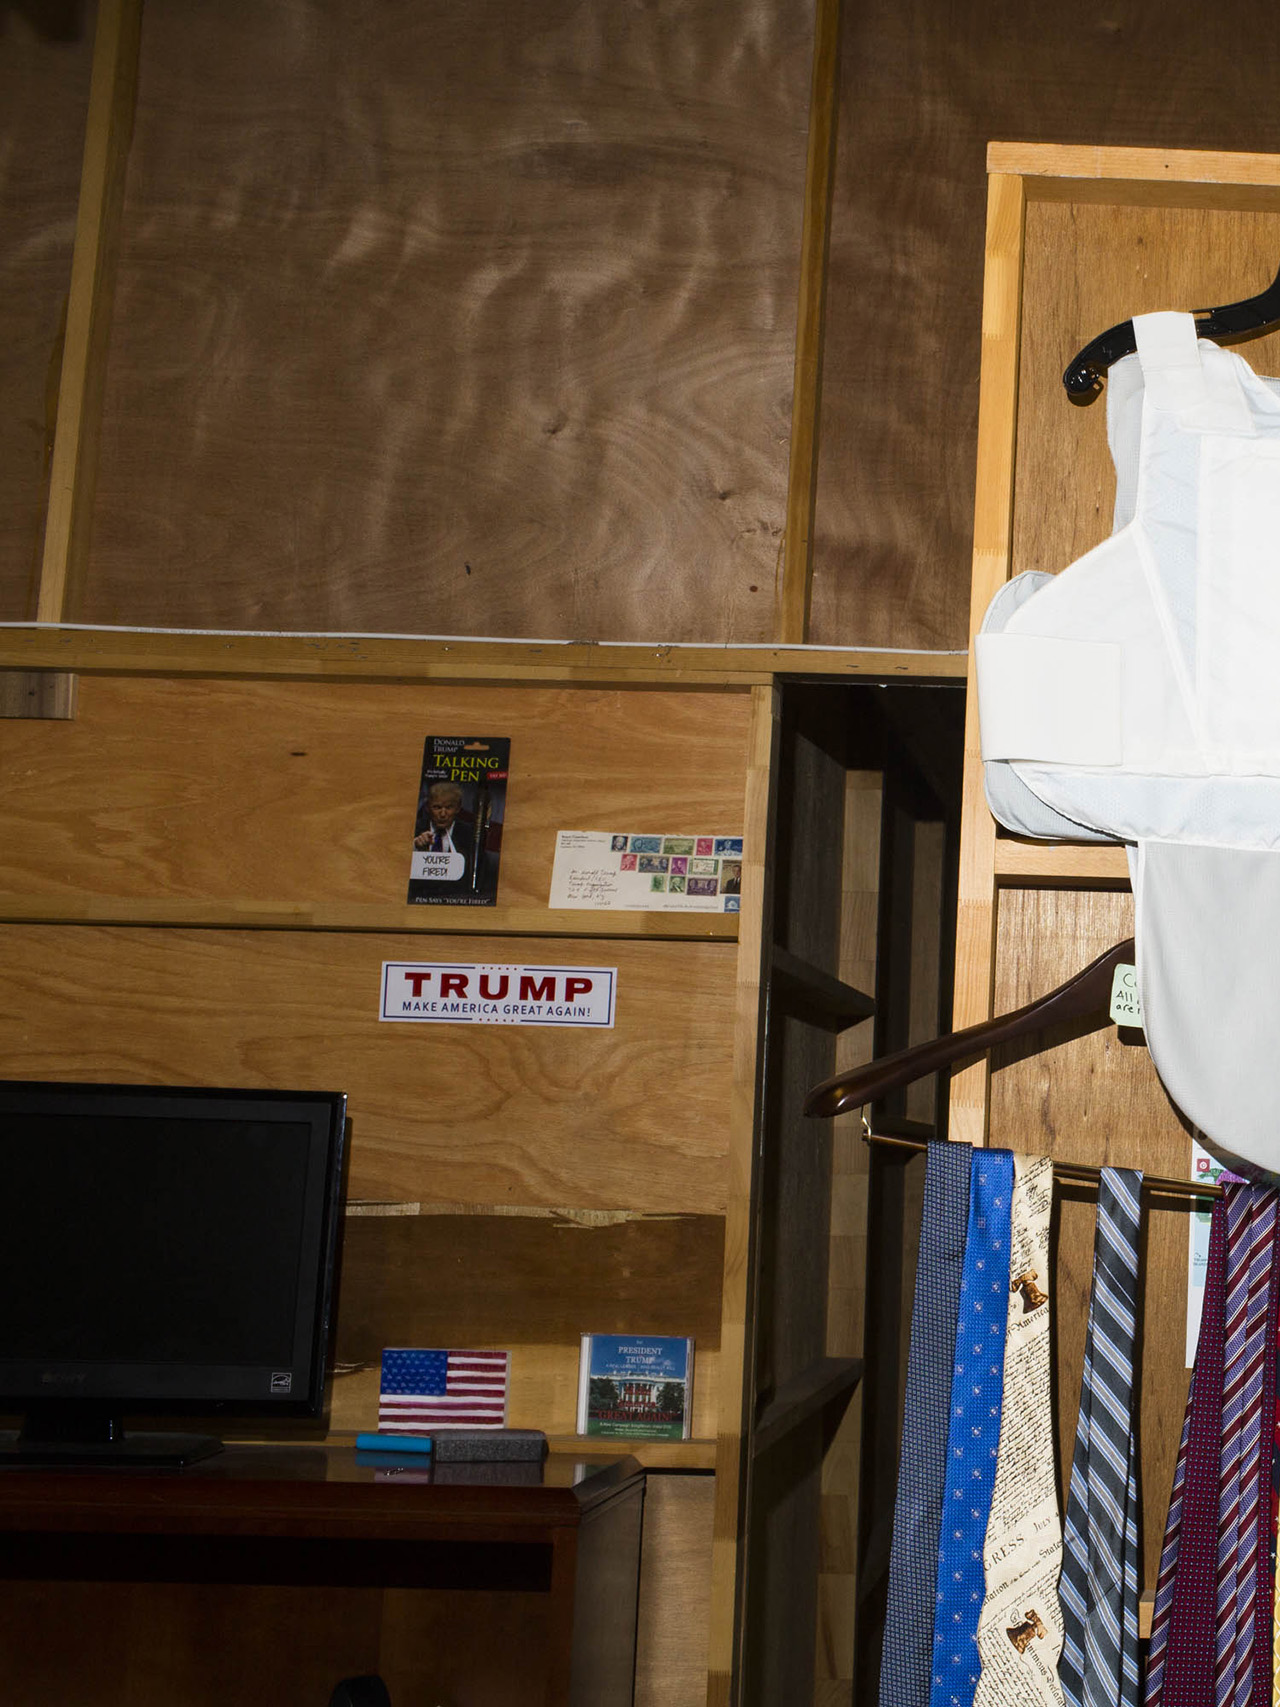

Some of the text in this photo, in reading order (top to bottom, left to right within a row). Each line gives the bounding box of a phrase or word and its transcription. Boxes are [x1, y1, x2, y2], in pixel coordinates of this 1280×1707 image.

[433, 738, 465, 746] DONALD
[433, 745, 458, 753] TRUMP
[433, 754, 499, 769] TALKING
[450, 768, 480, 782] PEN
[423, 855, 450, 865] YOU'RE
[422, 867, 448, 876] FIRED!
[404, 972, 593, 1003] TRUMP
[402, 1001, 591, 1017] MAKE AMERICA GREAT AGAIN!
[1116, 1004, 1134, 1014] are
[618, 1346, 663, 1355] PRESIDENT
[625, 1356, 656, 1364] TRUMP
